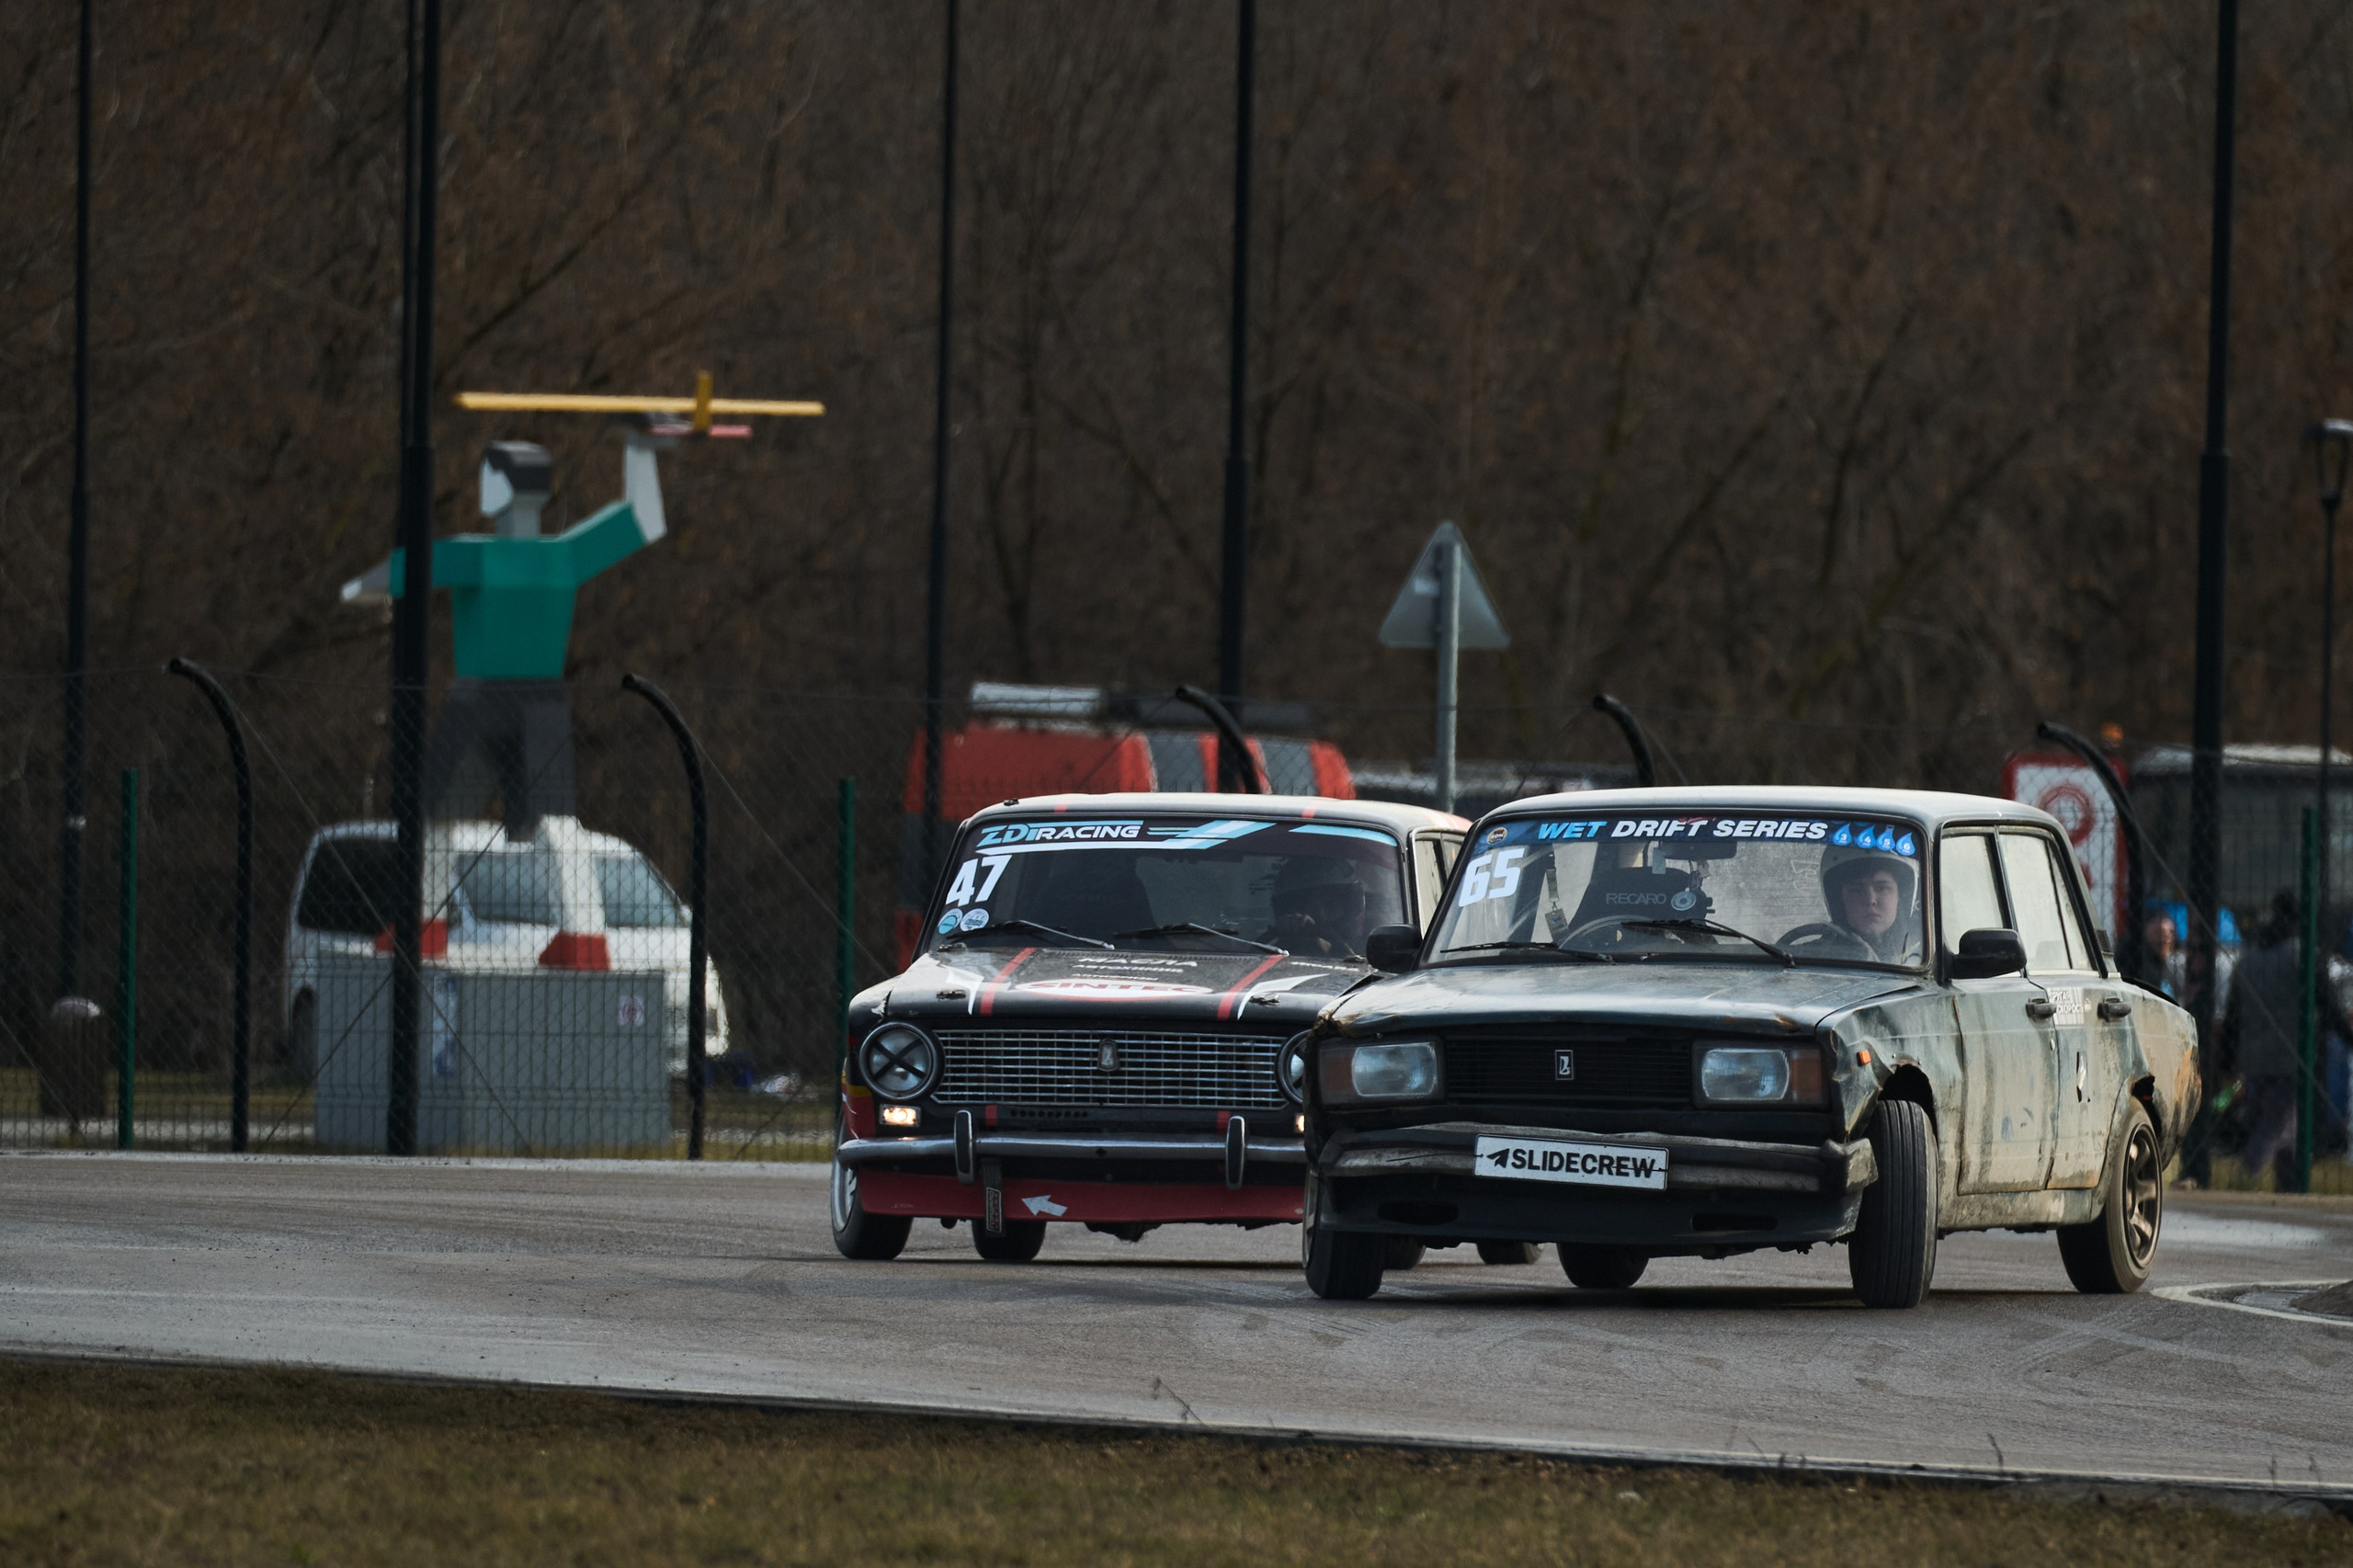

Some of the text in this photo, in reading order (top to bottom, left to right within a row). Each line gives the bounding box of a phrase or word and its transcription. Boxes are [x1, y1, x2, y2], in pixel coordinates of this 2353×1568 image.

[1537, 819, 1828, 839] WET DRIFT SERIES
[945, 854, 1012, 907] 47
[1459, 847, 1525, 907] 65
[1606, 892, 1667, 905] RECARO
[1077, 958, 1199, 968] МАСЛА
[1028, 983, 1200, 994] SINTEC
[1511, 1148, 1656, 1178] SLIDECREW
